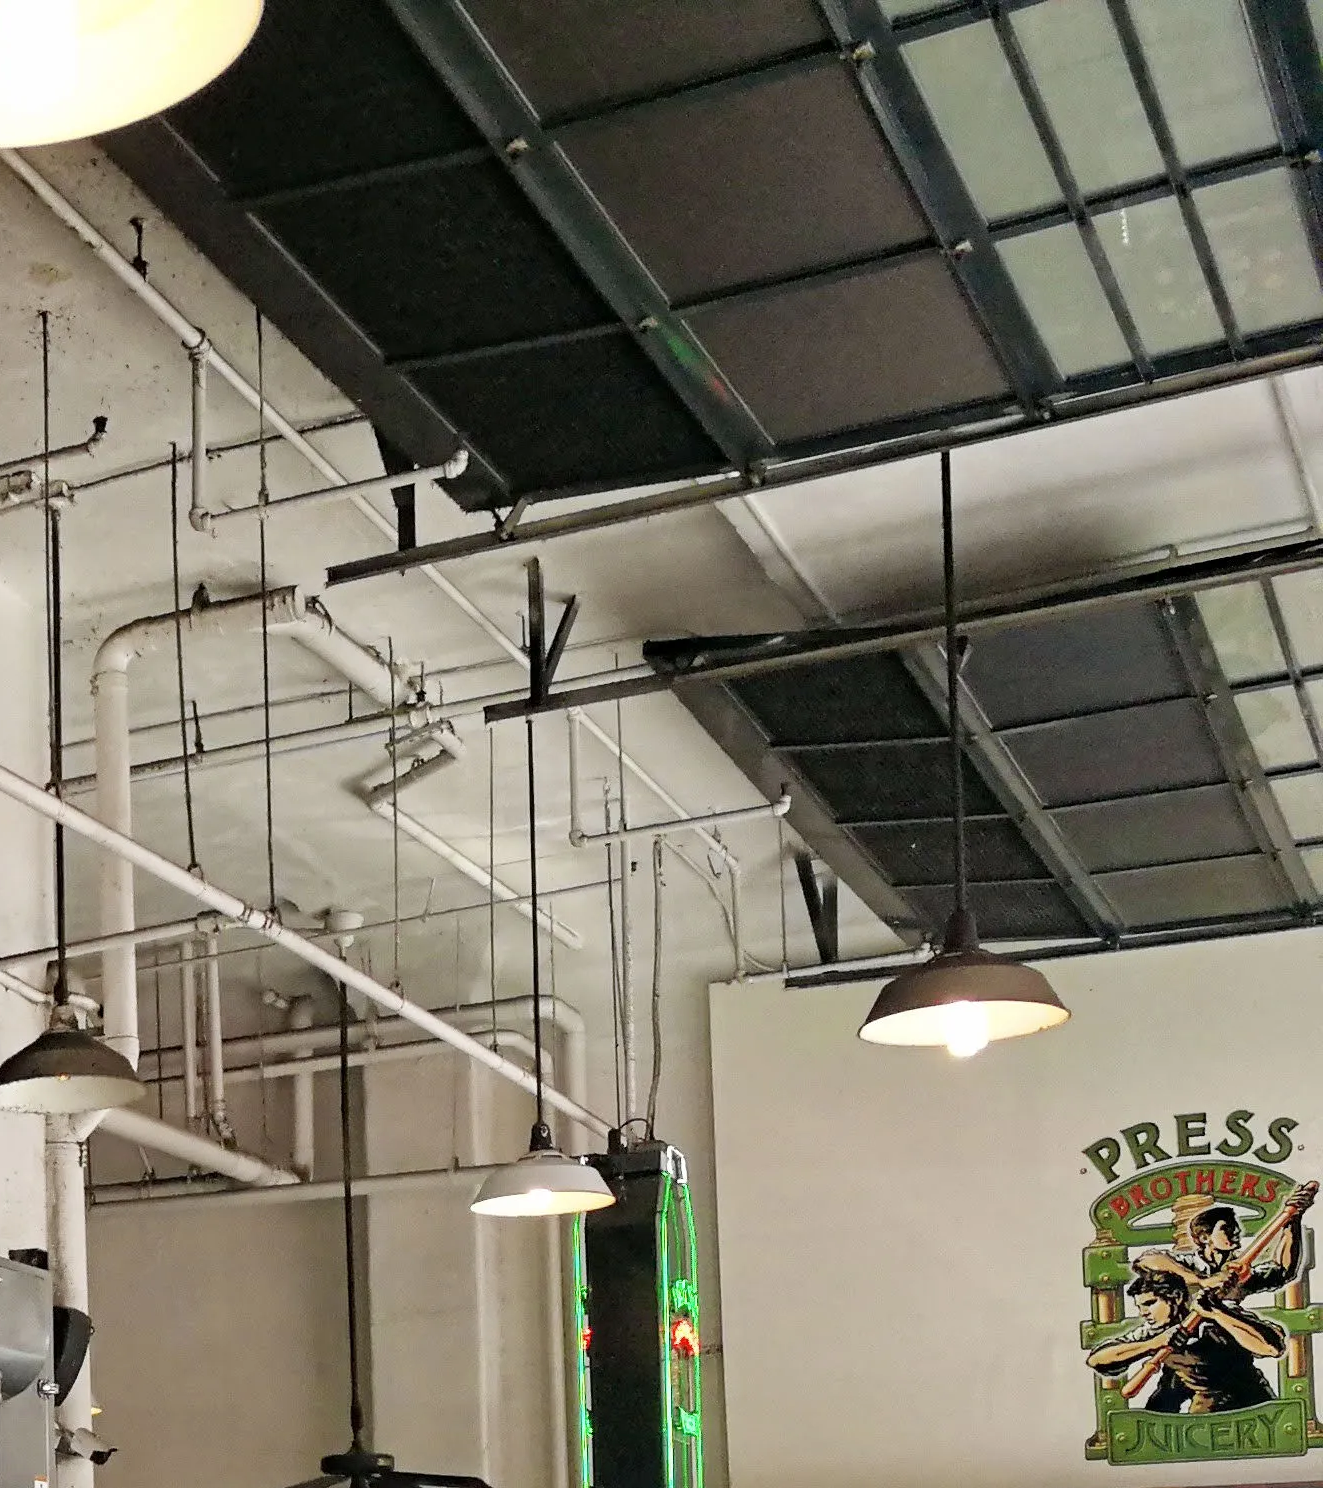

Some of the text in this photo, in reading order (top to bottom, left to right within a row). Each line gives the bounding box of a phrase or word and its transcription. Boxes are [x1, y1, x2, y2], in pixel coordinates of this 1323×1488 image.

[1082, 1109, 1300, 1184] PRESS
[1109, 1168, 1282, 1220] BROTHERS
[1125, 1408, 1285, 1453] JUICERY
